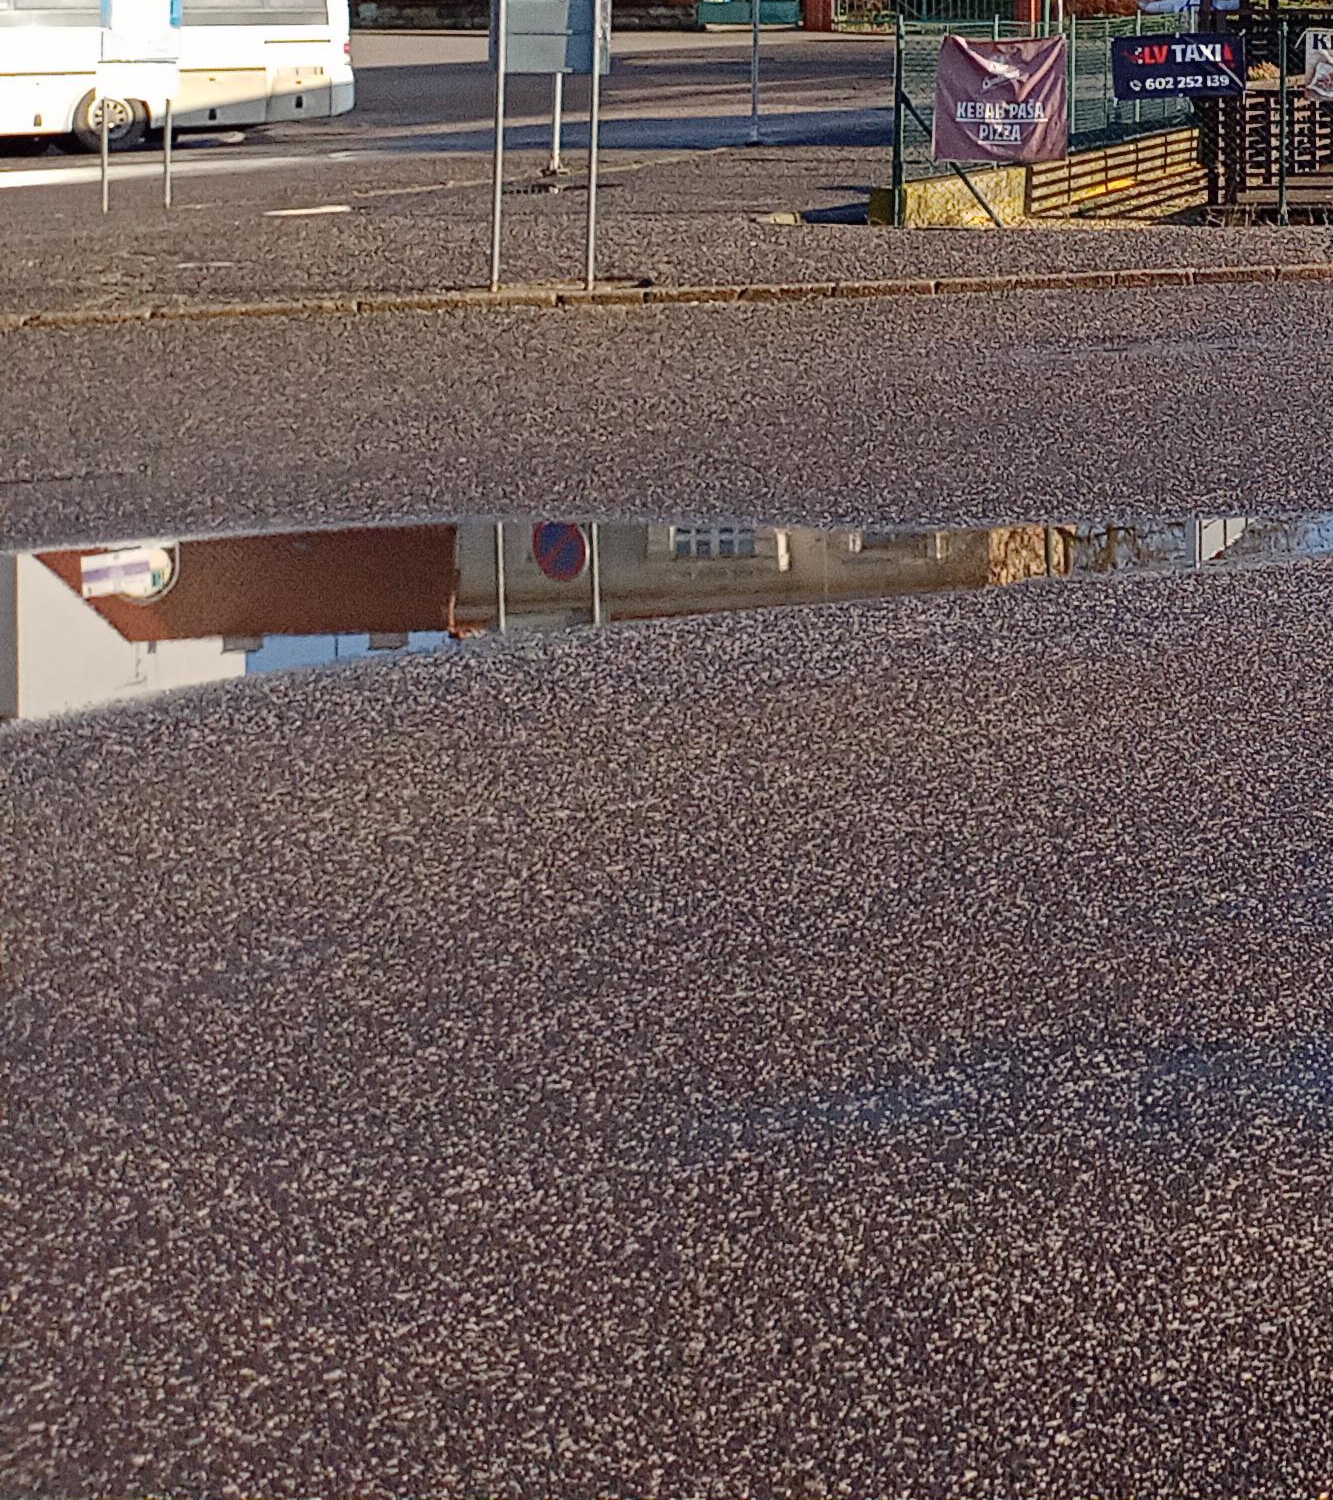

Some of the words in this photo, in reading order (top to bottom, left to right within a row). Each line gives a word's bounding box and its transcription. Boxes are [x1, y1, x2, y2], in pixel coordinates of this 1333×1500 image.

[1171, 43, 1222, 63] TAXI
[1145, 78, 1174, 90] 602
[1177, 76, 1203, 89] 252
[1206, 74, 1230, 87] 139
[956, 101, 1005, 119] KEBAB
[1009, 99, 1045, 119] PAŠA
[979, 124, 1021, 141] PIZZA
